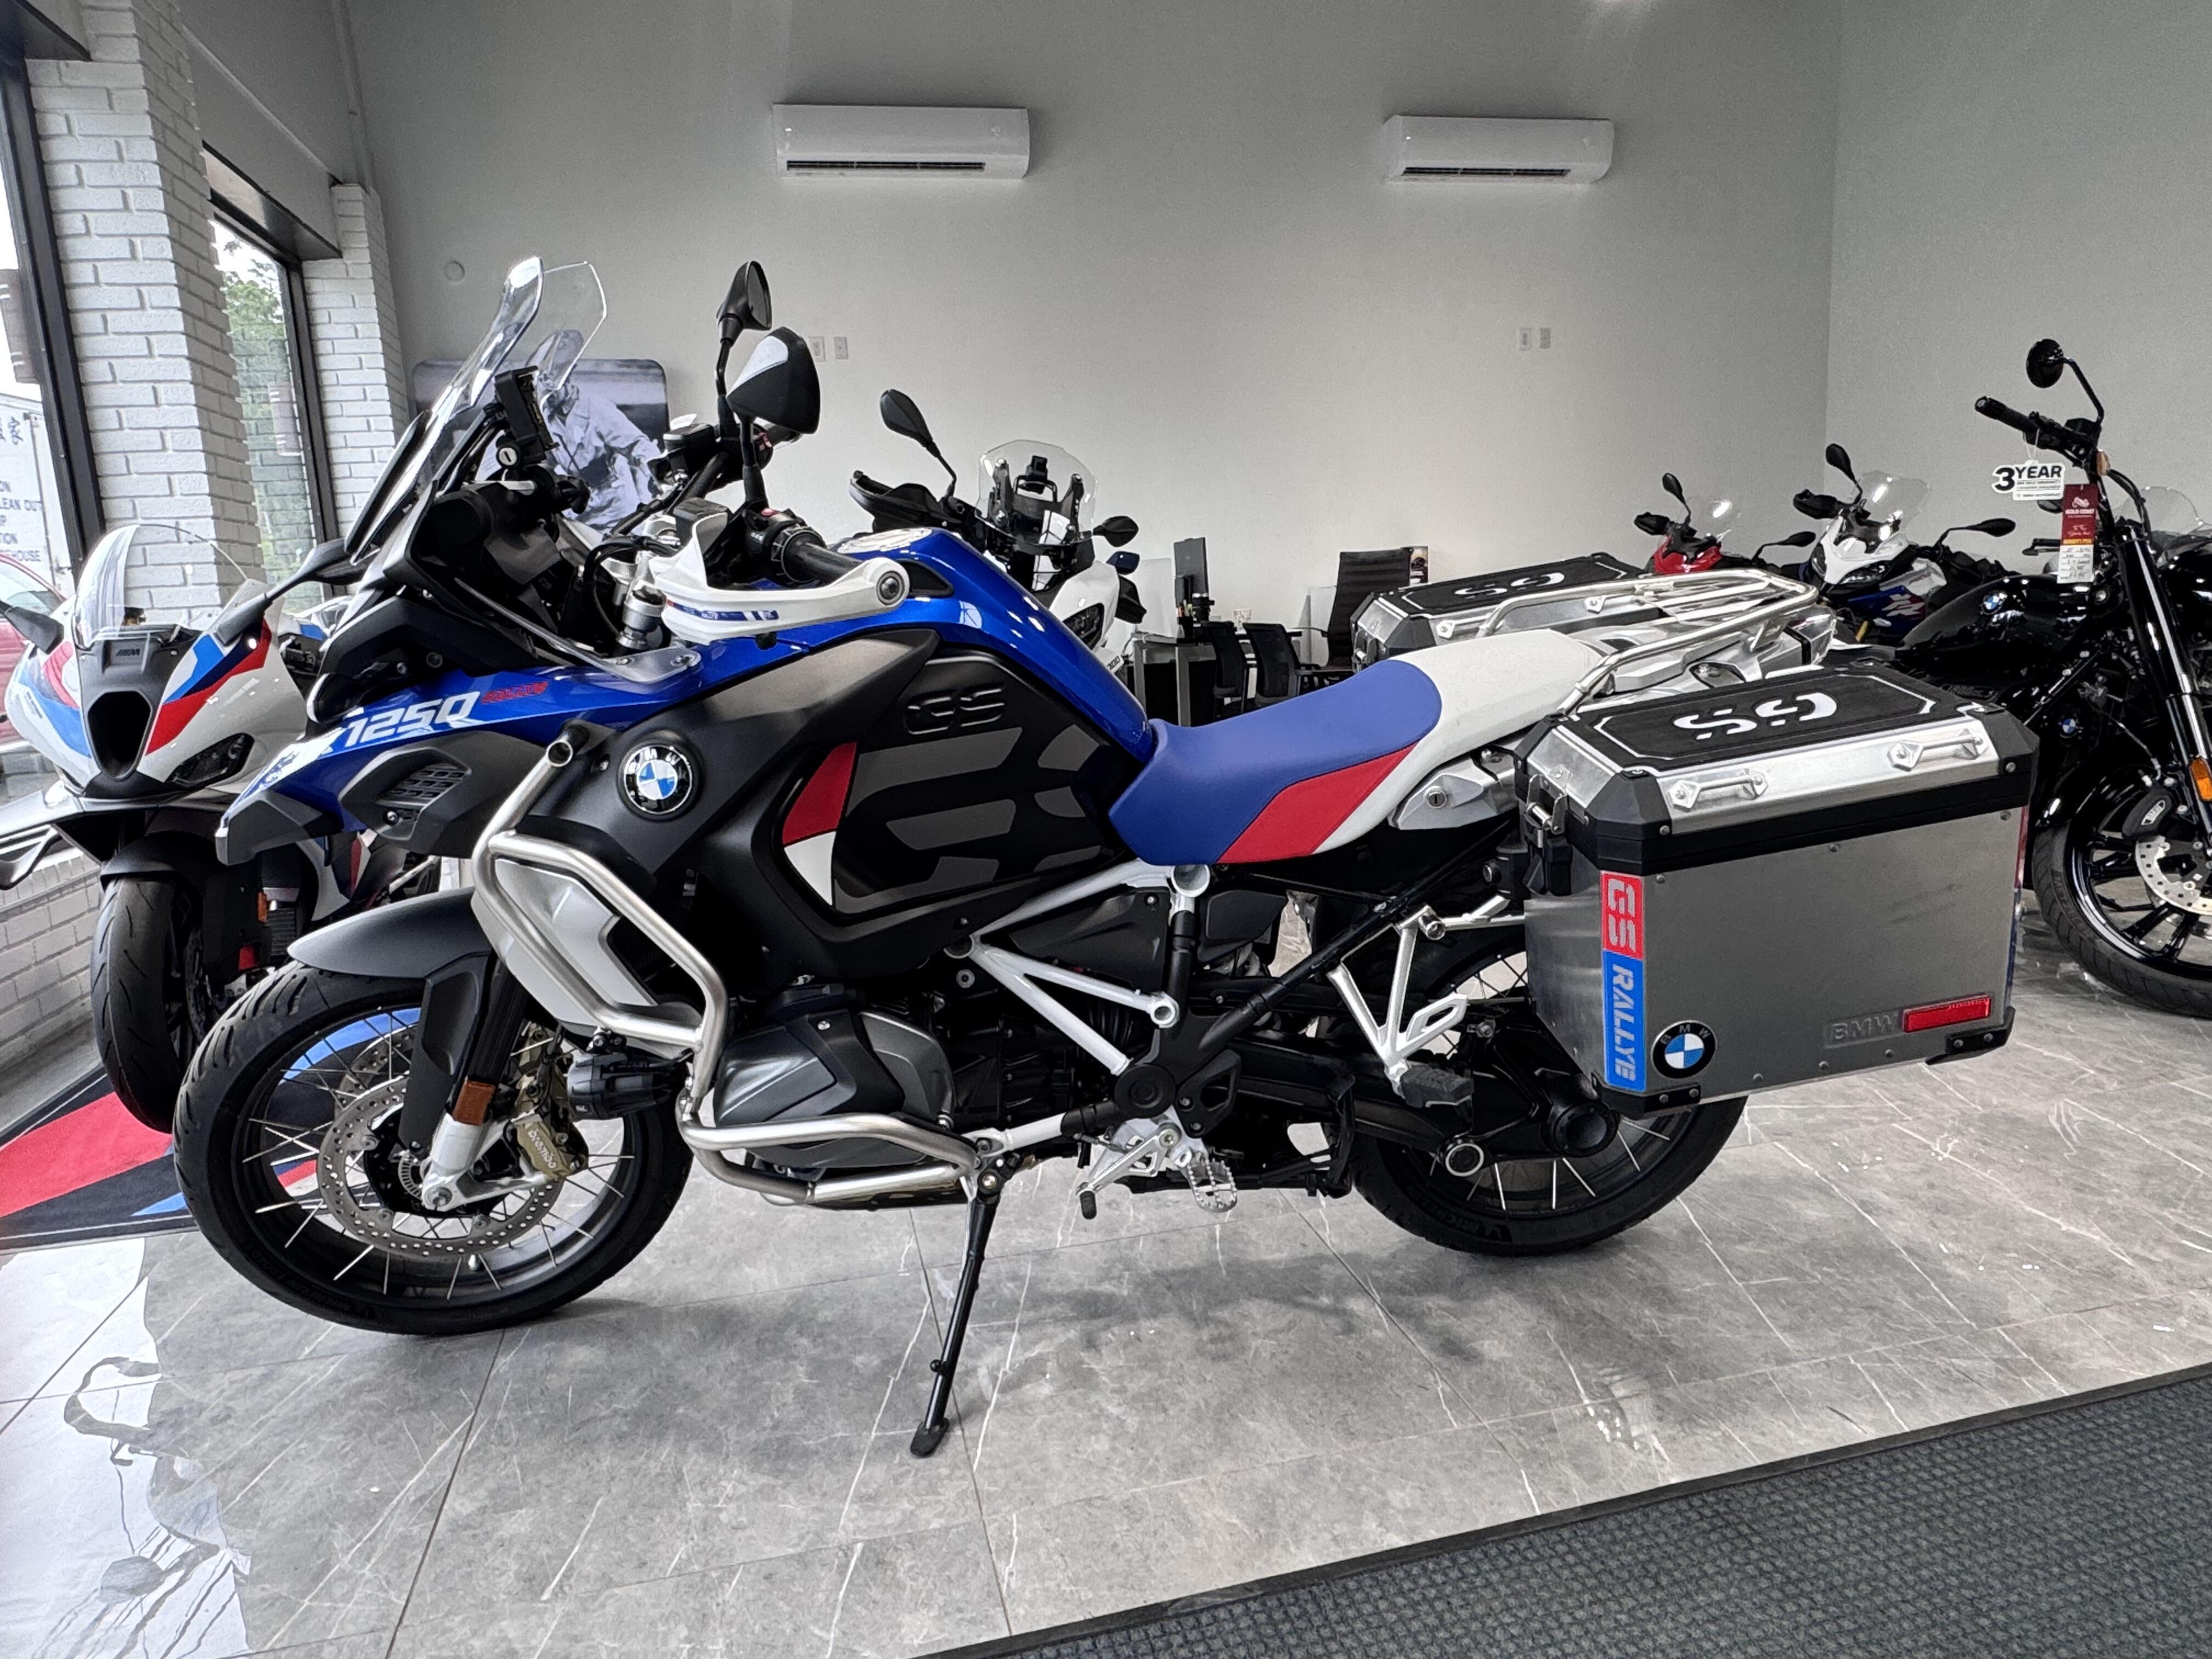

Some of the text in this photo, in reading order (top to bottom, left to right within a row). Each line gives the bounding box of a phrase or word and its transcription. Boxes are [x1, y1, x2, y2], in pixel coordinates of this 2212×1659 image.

[1995, 466, 2062, 491] 3 YEAR
[345, 691, 481, 747] 1250
[905, 682, 1005, 735] GS
[1607, 878, 1637, 1081] GS RALLYE
[1660, 1024, 1711, 1044] BMW
[1831, 1014, 1894, 1040] BMW
[528, 1129, 556, 1168] brembo
